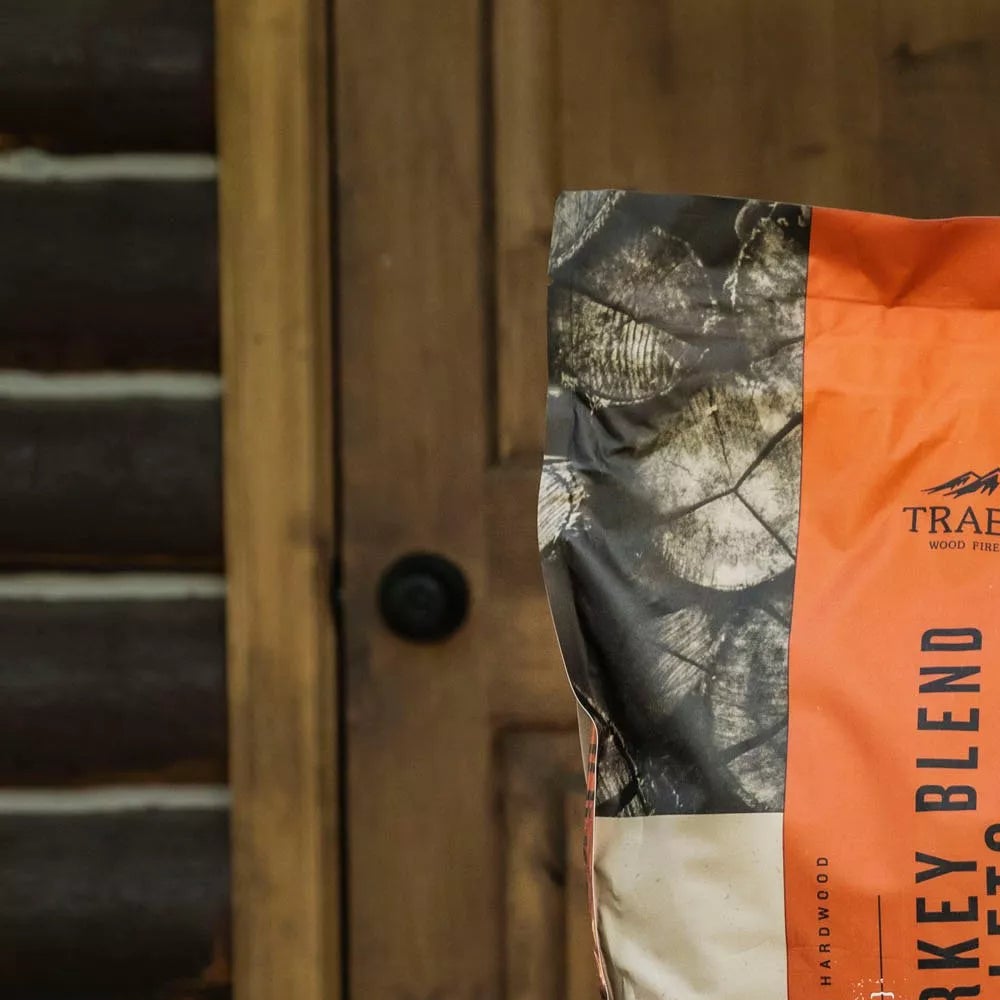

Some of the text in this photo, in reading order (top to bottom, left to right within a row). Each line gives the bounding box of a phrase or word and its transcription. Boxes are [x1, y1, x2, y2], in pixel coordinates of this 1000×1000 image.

[928, 540, 966, 550] WOOD
[915, 628, 982, 812] BLEND
[816, 856, 832, 986] HARDWOOD
